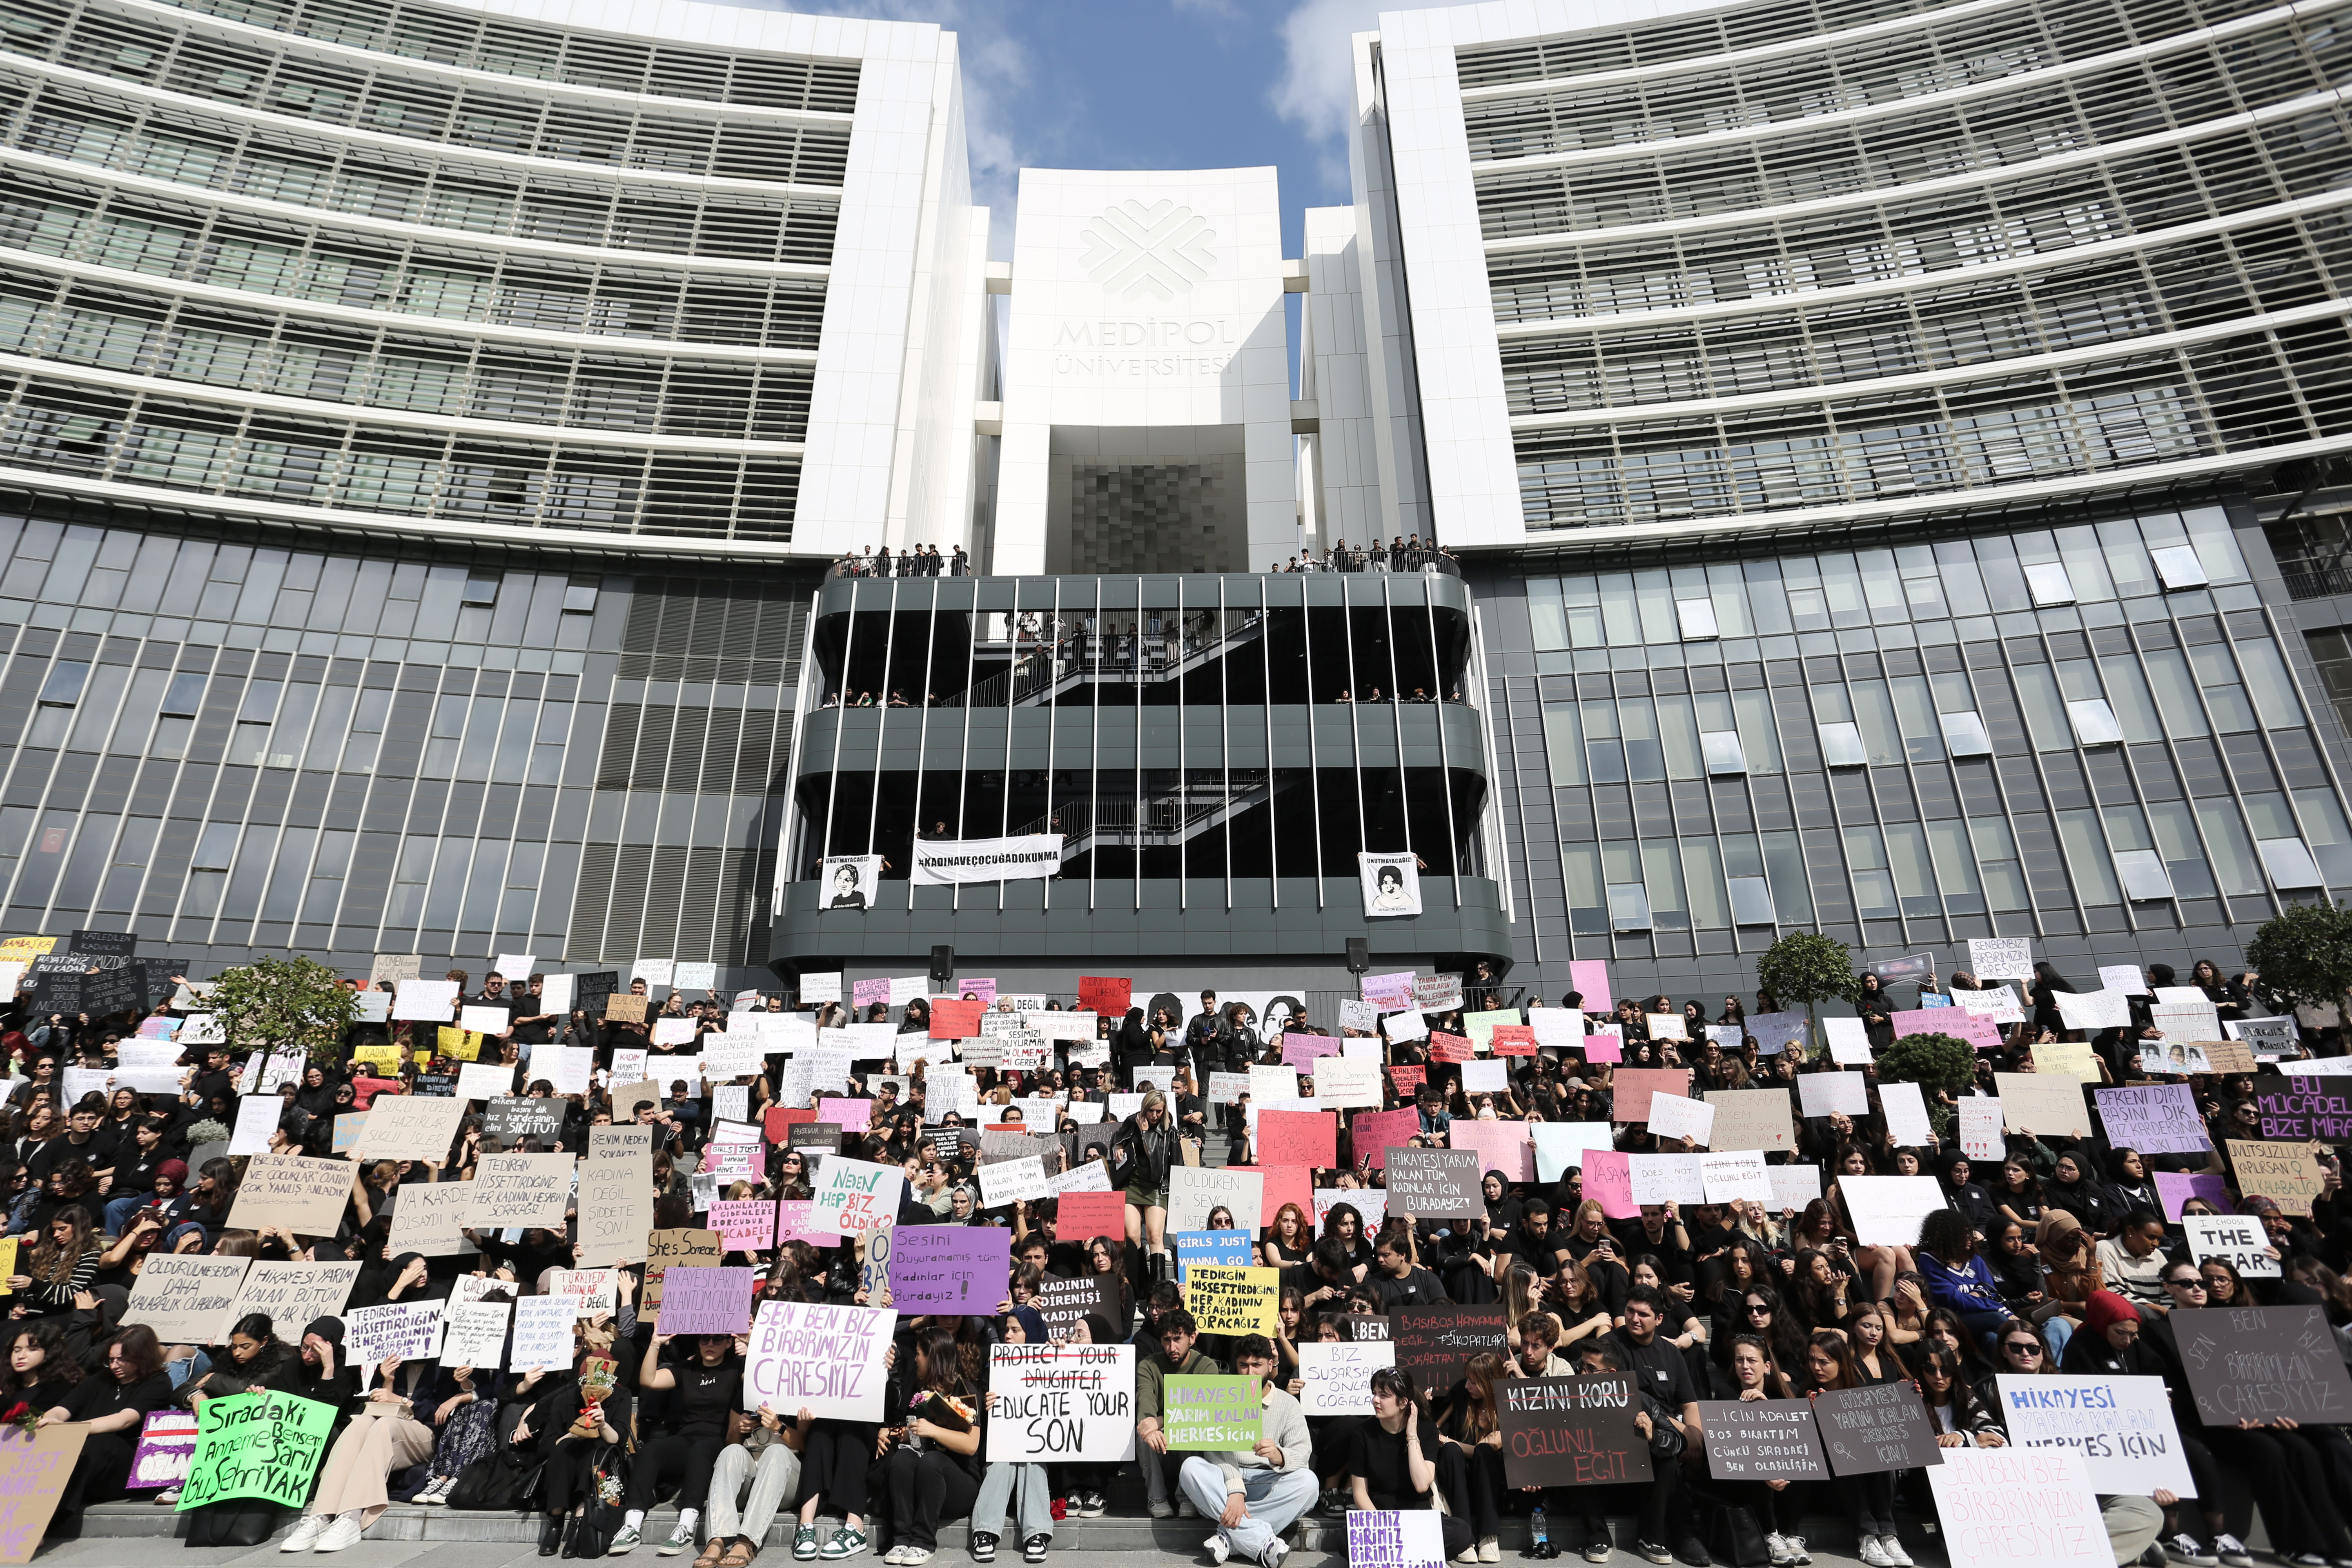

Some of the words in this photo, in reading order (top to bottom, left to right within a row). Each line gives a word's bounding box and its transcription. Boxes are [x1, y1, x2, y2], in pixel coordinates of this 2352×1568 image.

[1054, 318, 1235, 347] MEDİPOL
[1055, 353, 1232, 376] ÜNİVERSİTESİ
[1975, 962, 2032, 977] ÇARESİYİZ
[1417, 976, 1437, 984] YANAN
[1418, 982, 1450, 992] KADINLARIN
[611, 996, 629, 1004] REAL
[630, 997, 646, 1006] MEN
[1017, 1000, 1039, 1009] DEĞİL
[1342, 1002, 1371, 1013] YASTA
[1009, 1029, 1041, 1038] SESİMİZİ
[708, 1042, 755, 1050] GİDENLERE
[1003, 1038, 1047, 1047] DUYURMAK
[707, 1051, 756, 1062] BORCUDUR
[1013, 1047, 1052, 1057] ÖLMEMİZ
[706, 1062, 756, 1072] MÜCADELE
[1014, 1058, 1039, 1066] GEREK
[2291, 1076, 2321, 1094] BU
[491, 1096, 517, 1105] öfkeni
[521, 1097, 536, 1106] diri
[2097, 1088, 2149, 1107] ÖFKENİ
[2154, 1086, 2182, 1104] DİRİ
[2102, 1107, 2149, 1123] BAŞINI
[2162, 1104, 2191, 1120] DİK
[484, 1123, 501, 1132] elini
[532, 1122, 559, 1133] TUT
[2107, 1123, 2131, 1138] KIZ
[2261, 1115, 2307, 1137] BİZE
[711, 1145, 733, 1154] GIRLS
[2149, 1138, 2172, 1152] SIKI
[2175, 1136, 2205, 1150] TUT
[2228, 1143, 2316, 1160] UMUTSUZLUĞA
[1391, 1151, 1441, 1169] HİKAYESİ
[1441, 1154, 1479, 1168] YARIM
[2237, 1161, 2289, 1175] KAPILIRSAN
[587, 1168, 634, 1182] KADINA
[717, 1165, 735, 1174] HAVE
[1392, 1168, 1423, 1180] KALAN
[1424, 1169, 1448, 1181] TÜM
[1642, 1169, 1664, 1178] DOES
[1707, 1172, 1740, 1184] OĞLUNU
[1742, 1171, 1762, 1180] EĞİT
[832, 1166, 884, 1192] NEDEN
[2240, 1178, 2254, 1193] BU
[2256, 1179, 2318, 1195] KALABALIĞI
[592, 1185, 631, 1201] DEĞİL
[1392, 1182, 1434, 1194] KADINLAR
[1439, 1181, 1460, 1195] İÇİN
[820, 1192, 846, 1208] HEP
[846, 1193, 875, 1214] BİZ
[1406, 1195, 1470, 1211] BURADAYIZ!
[595, 1220, 629, 1237] SON!
[897, 1232, 951, 1246] Sesini
[1178, 1236, 1213, 1248] GİRLS
[1219, 1237, 1246, 1246] JUST
[2199, 1229, 2254, 1246] THE
[897, 1252, 971, 1264] Duyuramamış
[1178, 1256, 1219, 1267] WANNA
[1226, 1256, 1244, 1265] GO
[147, 1258, 242, 1278] ÖLDÜRÜLMESEYDİK
[895, 1270, 945, 1281] Kadınlar
[952, 1270, 974, 1281] için
[1192, 1269, 1246, 1281] TEDİRGİN
[163, 1279, 201, 1296] DAHA
[1040, 1278, 1094, 1293] KADININ
[1192, 1281, 1278, 1295] HİSSETTİRDİĞİNİZ
[130, 1294, 180, 1312] KALABALIK
[894, 1289, 953, 1303] Burdayız
[1040, 1290, 1101, 1307] DİRENİŞİ
[1191, 1294, 1213, 1305] HER
[1218, 1296, 1263, 1307] KADININ
[758, 1302, 796, 1326] SEN
[804, 1305, 840, 1330] BEN
[844, 1306, 881, 1336] BİZ
[1191, 1306, 1243, 1316] HESABINI
[1401, 1315, 1454, 1330] BAŞIBOŞ
[2229, 1310, 2266, 1332] BEN
[760, 1325, 871, 1361] BİRBİRİMİZİN
[2188, 1332, 2216, 1369] SEN
[991, 1345, 1059, 1367] PROTECT
[1078, 1346, 1118, 1365] YOUR
[1329, 1346, 1361, 1362] BİZ
[1396, 1354, 1455, 1368] SOKAKTAN
[2224, 1351, 2314, 1382] BİRBİRİMİZİN
[1024, 1370, 1102, 1390] DAUGHTER
[1169, 1383, 1245, 1404] HİKAYESİ
[1503, 1384, 1571, 1412] KIZINI
[1579, 1380, 1629, 1409] KORU
[2010, 1384, 2116, 1409] HİKAYESİ
[2217, 1381, 2343, 1415] ÇARESİYİZ
[991, 1392, 1070, 1419] EDUCATE
[1086, 1392, 1129, 1417] YOUR
[205, 1394, 306, 1434] Sıradaki
[1167, 1408, 1209, 1423] YARIM
[1214, 1407, 1259, 1423] KALAN
[1723, 1409, 1754, 1423] İÇİN
[1760, 1412, 1809, 1422] ADALET
[1832, 1410, 1875, 1429] YARIM
[1878, 1405, 1920, 1425] KALAN
[2017, 1410, 2088, 1434] YARIM
[2089, 1408, 2155, 1432] KALAN
[272, 1421, 323, 1447] Bensem
[1026, 1418, 1083, 1454] SON
[1169, 1426, 1225, 1445] HERKES
[1740, 1428, 1798, 1440] BIRAKTIM
[1860, 1423, 1909, 1443] HERKES
[205, 1430, 271, 1461] Anneme
[1511, 1427, 1595, 1457] OĞLUNU
[2117, 1431, 2166, 1459] İÇİN
[261, 1439, 316, 1471] Sarıl
[1713, 1446, 1750, 1458] ÇÜNKÜ
[1757, 1443, 1809, 1457] SIRADAKİ
[1573, 1451, 1628, 1482] EĞİT
[1725, 1461, 1744, 1472] BEN
[1755, 1459, 1818, 1472] OLABİLİRİM
[1939, 1454, 1987, 1486] SEN,
[1985, 1456, 2029, 1484] BEN,
[2031, 1454, 2070, 1483] BİZ
[184, 1467, 211, 1503] Bu
[263, 1466, 309, 1502] YAK
[1946, 1488, 2084, 1521] BİRBİRİMİZİN
[1348, 1511, 1401, 1527] HEPİMİZ
[1350, 1528, 1402, 1546] BİRİMİZ
[1351, 1545, 1403, 1562] BİRİMİZ
